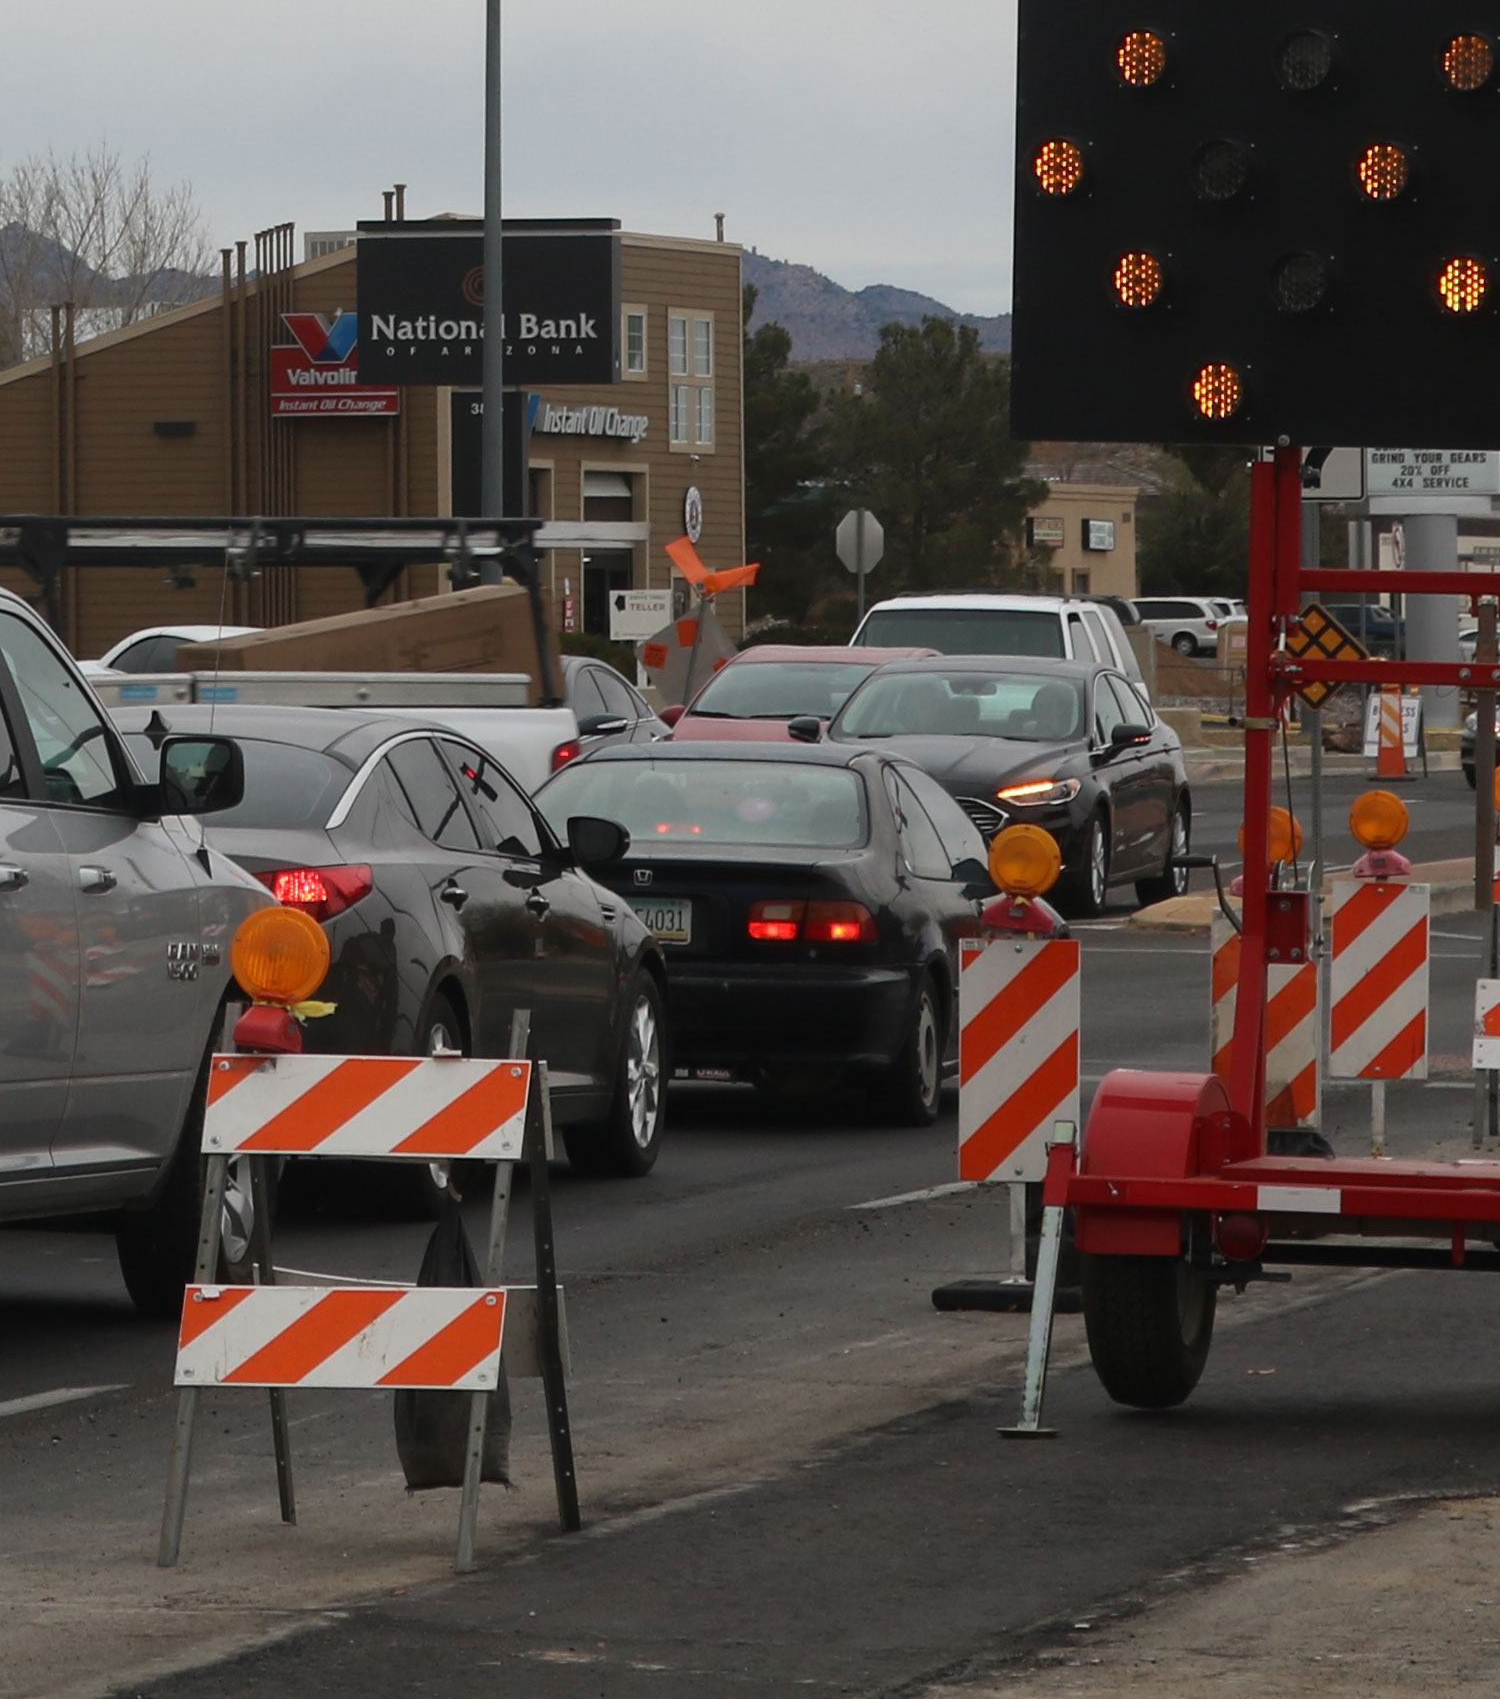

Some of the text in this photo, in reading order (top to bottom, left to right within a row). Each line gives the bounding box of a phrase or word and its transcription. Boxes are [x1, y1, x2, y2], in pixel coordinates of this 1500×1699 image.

[371, 312, 598, 341] Nationl Bank
[386, 345, 585, 356] OF ARZONA
[279, 399, 387, 411] Instant Oil Change
[543, 404, 648, 443] Instant Oil Change
[1371, 452, 1487, 464] GRIND YOUR GEARS
[1400, 465, 1450, 476] 20% OFF
[1391, 477, 1470, 489] 4X4 SERVICE
[630, 603, 666, 611] TELLER
